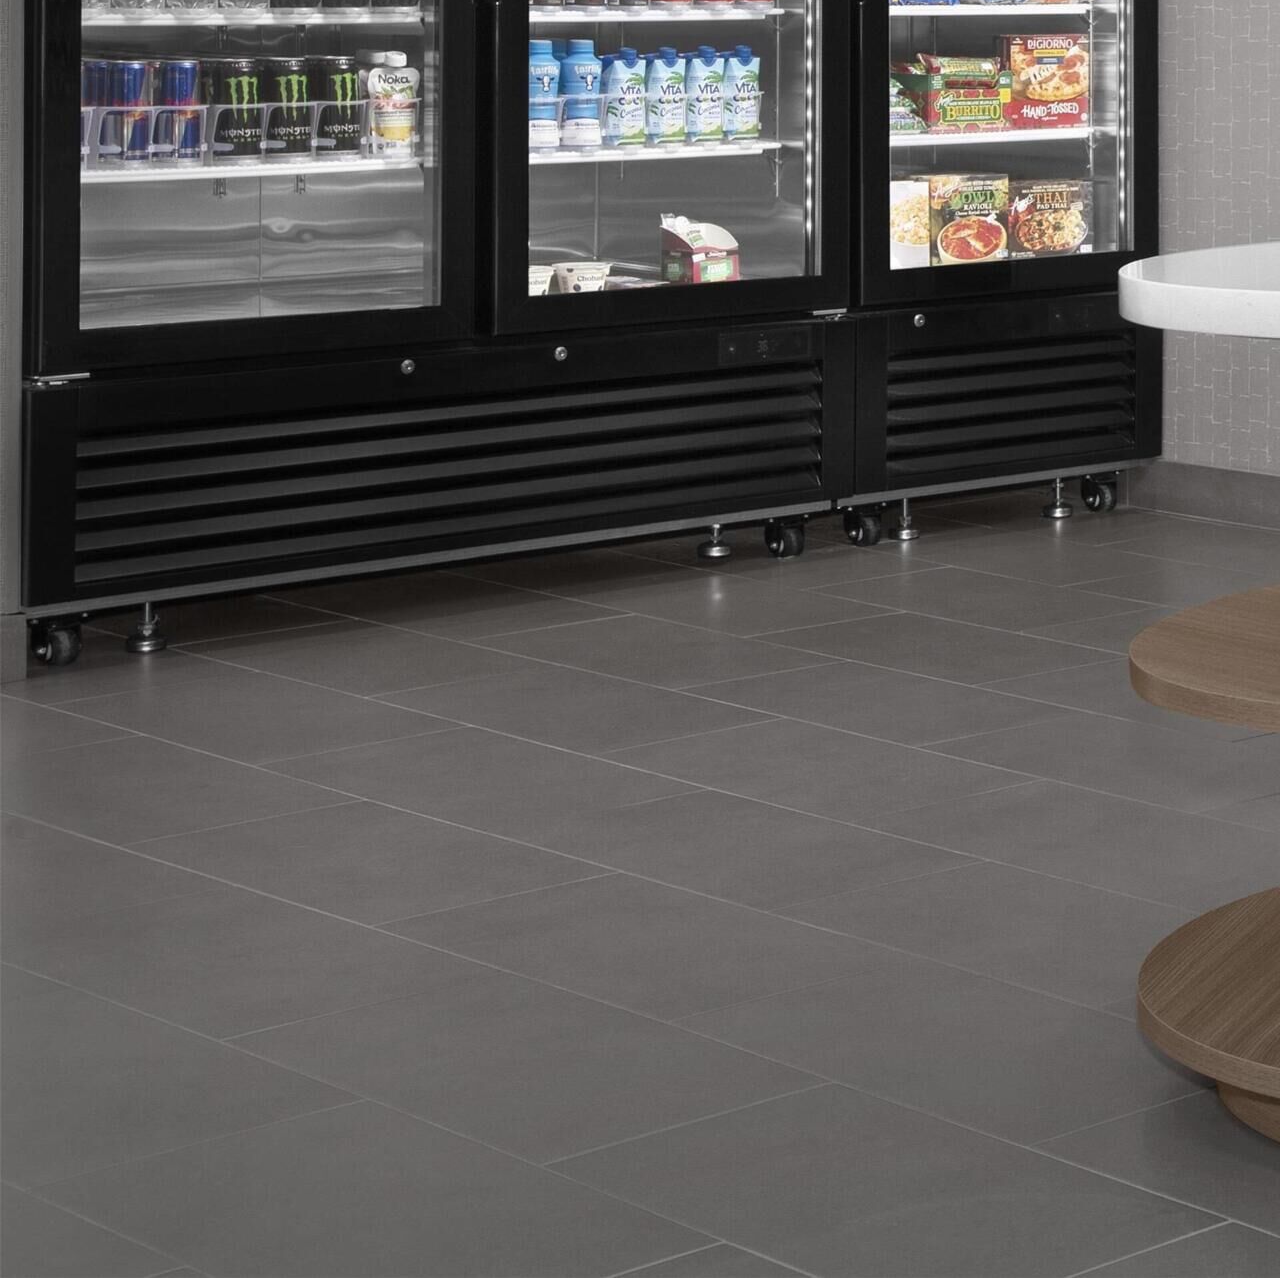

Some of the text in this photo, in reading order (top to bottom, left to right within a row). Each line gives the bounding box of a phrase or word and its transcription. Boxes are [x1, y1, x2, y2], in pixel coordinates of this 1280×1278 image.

[1028, 39, 1072, 49] DIGIORNO
[378, 74, 410, 84] Noka
[620, 86, 641, 95] VITA
[661, 85, 682, 95] VITA
[698, 84, 719, 94] VITA
[735, 83, 756, 93] VITA
[947, 105, 999, 119] BURRITO
[220, 125, 261, 137] MONSTE
[271, 126, 312, 136] MONSTE
[1036, 192, 1067, 203] THAI
